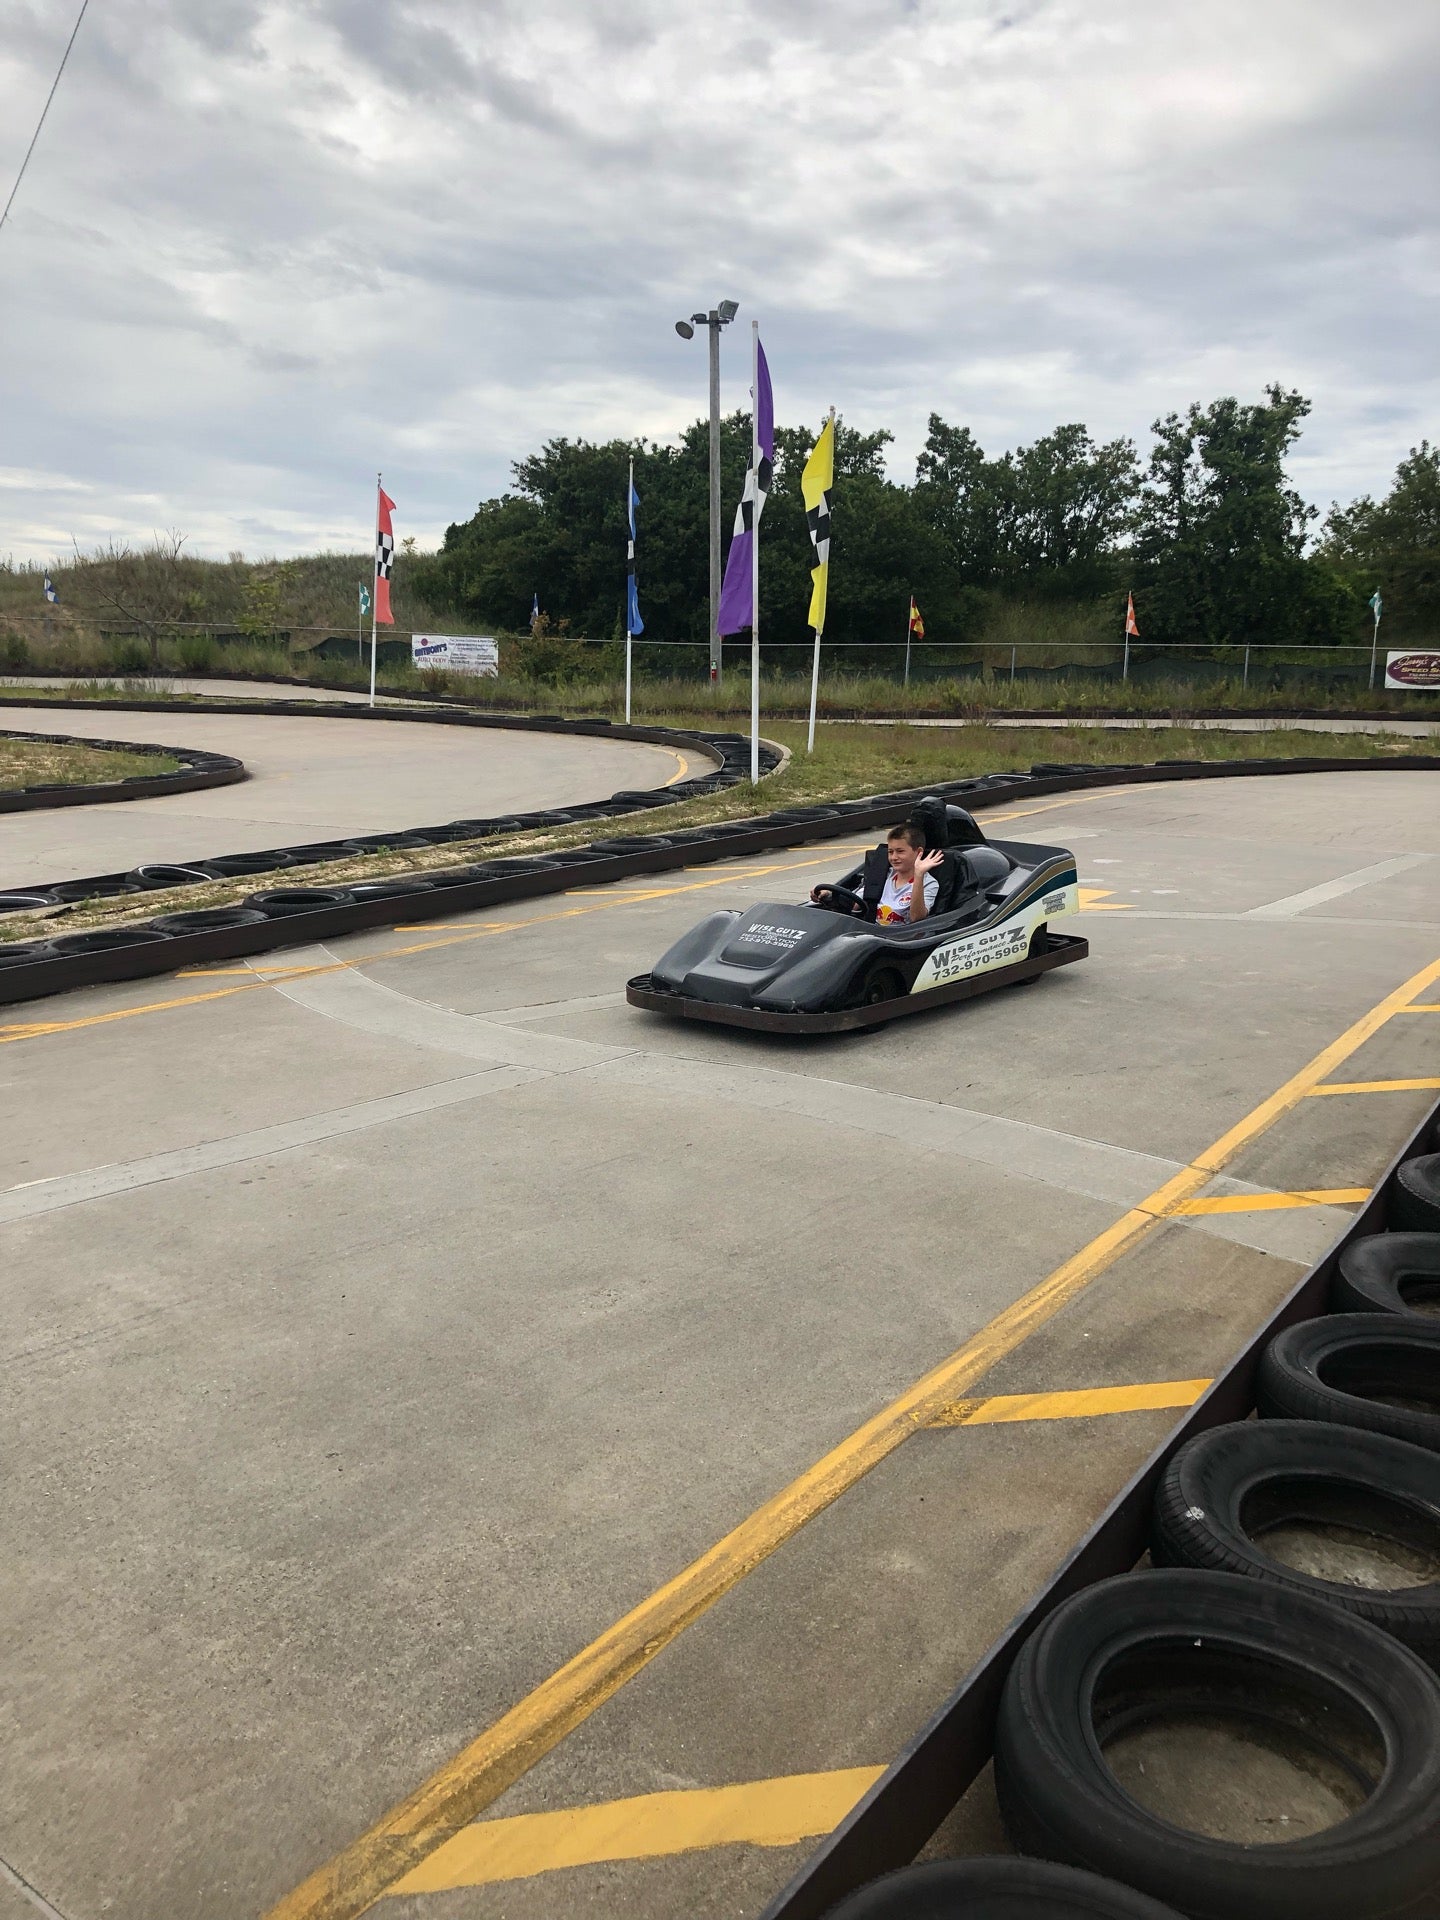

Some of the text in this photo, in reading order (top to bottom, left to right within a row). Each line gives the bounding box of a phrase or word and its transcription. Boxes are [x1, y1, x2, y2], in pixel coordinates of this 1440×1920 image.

[748, 924, 776, 932] WISE
[776, 927, 808, 940] GUYZ
[932, 926, 1027, 969] WISE GUYZ
[932, 942, 1028, 981] 732-970-5969
